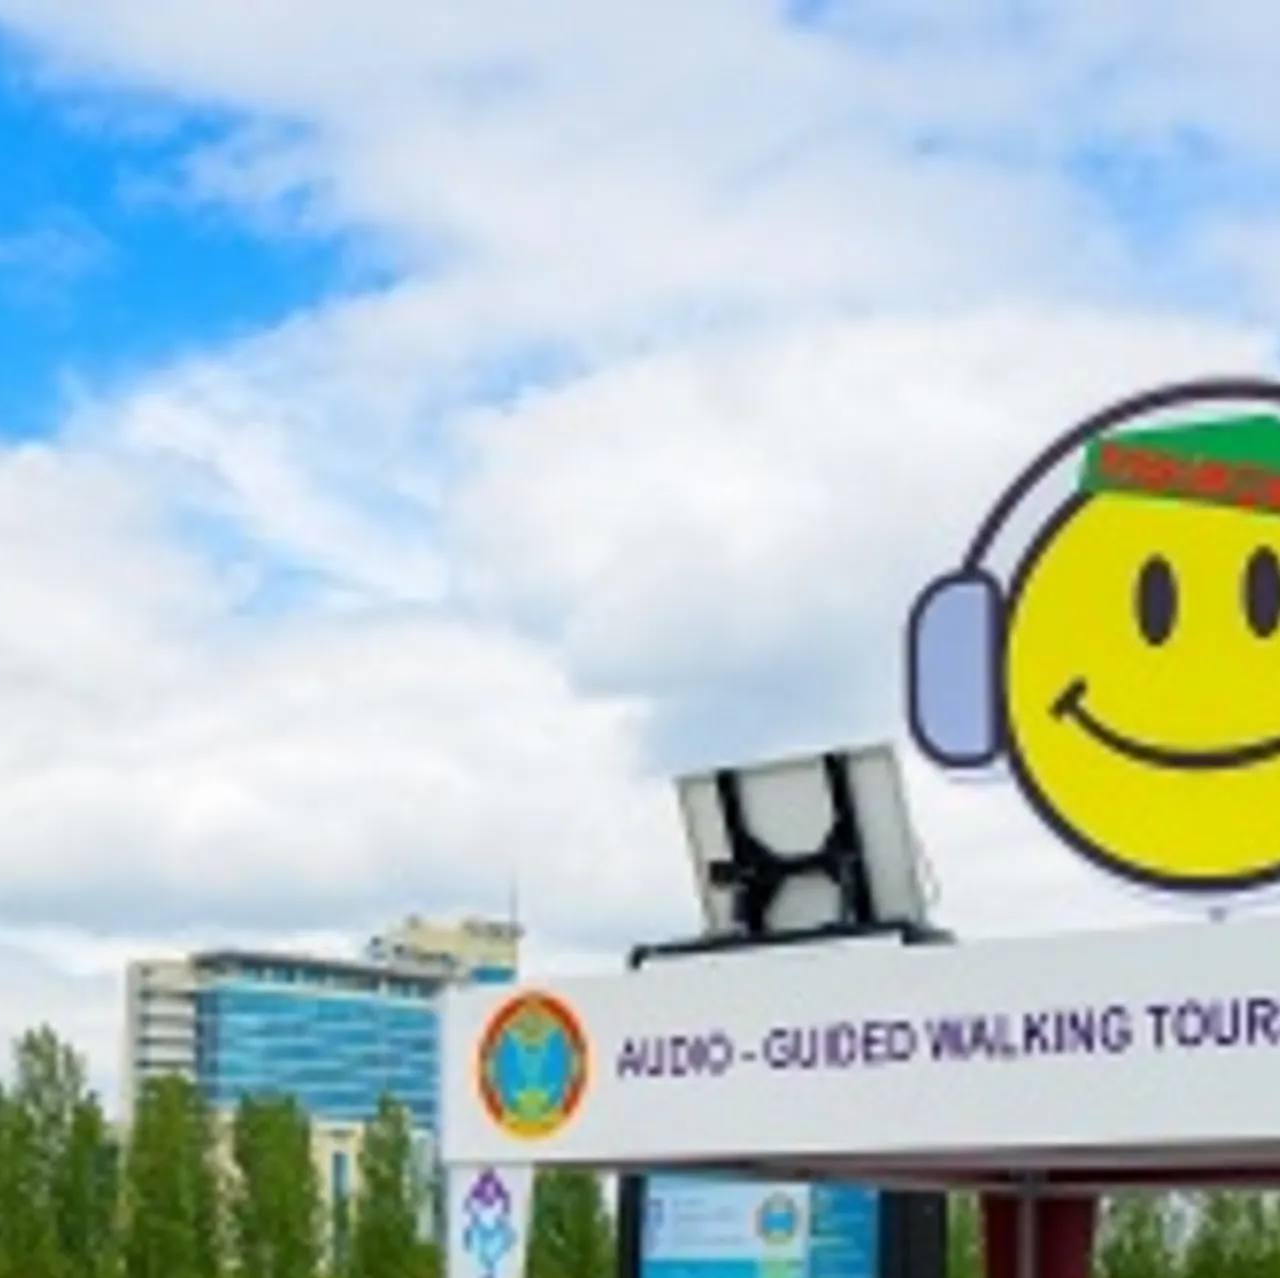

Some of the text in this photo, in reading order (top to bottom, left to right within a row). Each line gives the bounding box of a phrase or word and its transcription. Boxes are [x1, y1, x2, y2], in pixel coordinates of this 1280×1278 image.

[617, 1032, 733, 1077] AUDIO
[764, 1021, 917, 1068] GUIDED
[923, 1005, 1132, 1060] WALKING
